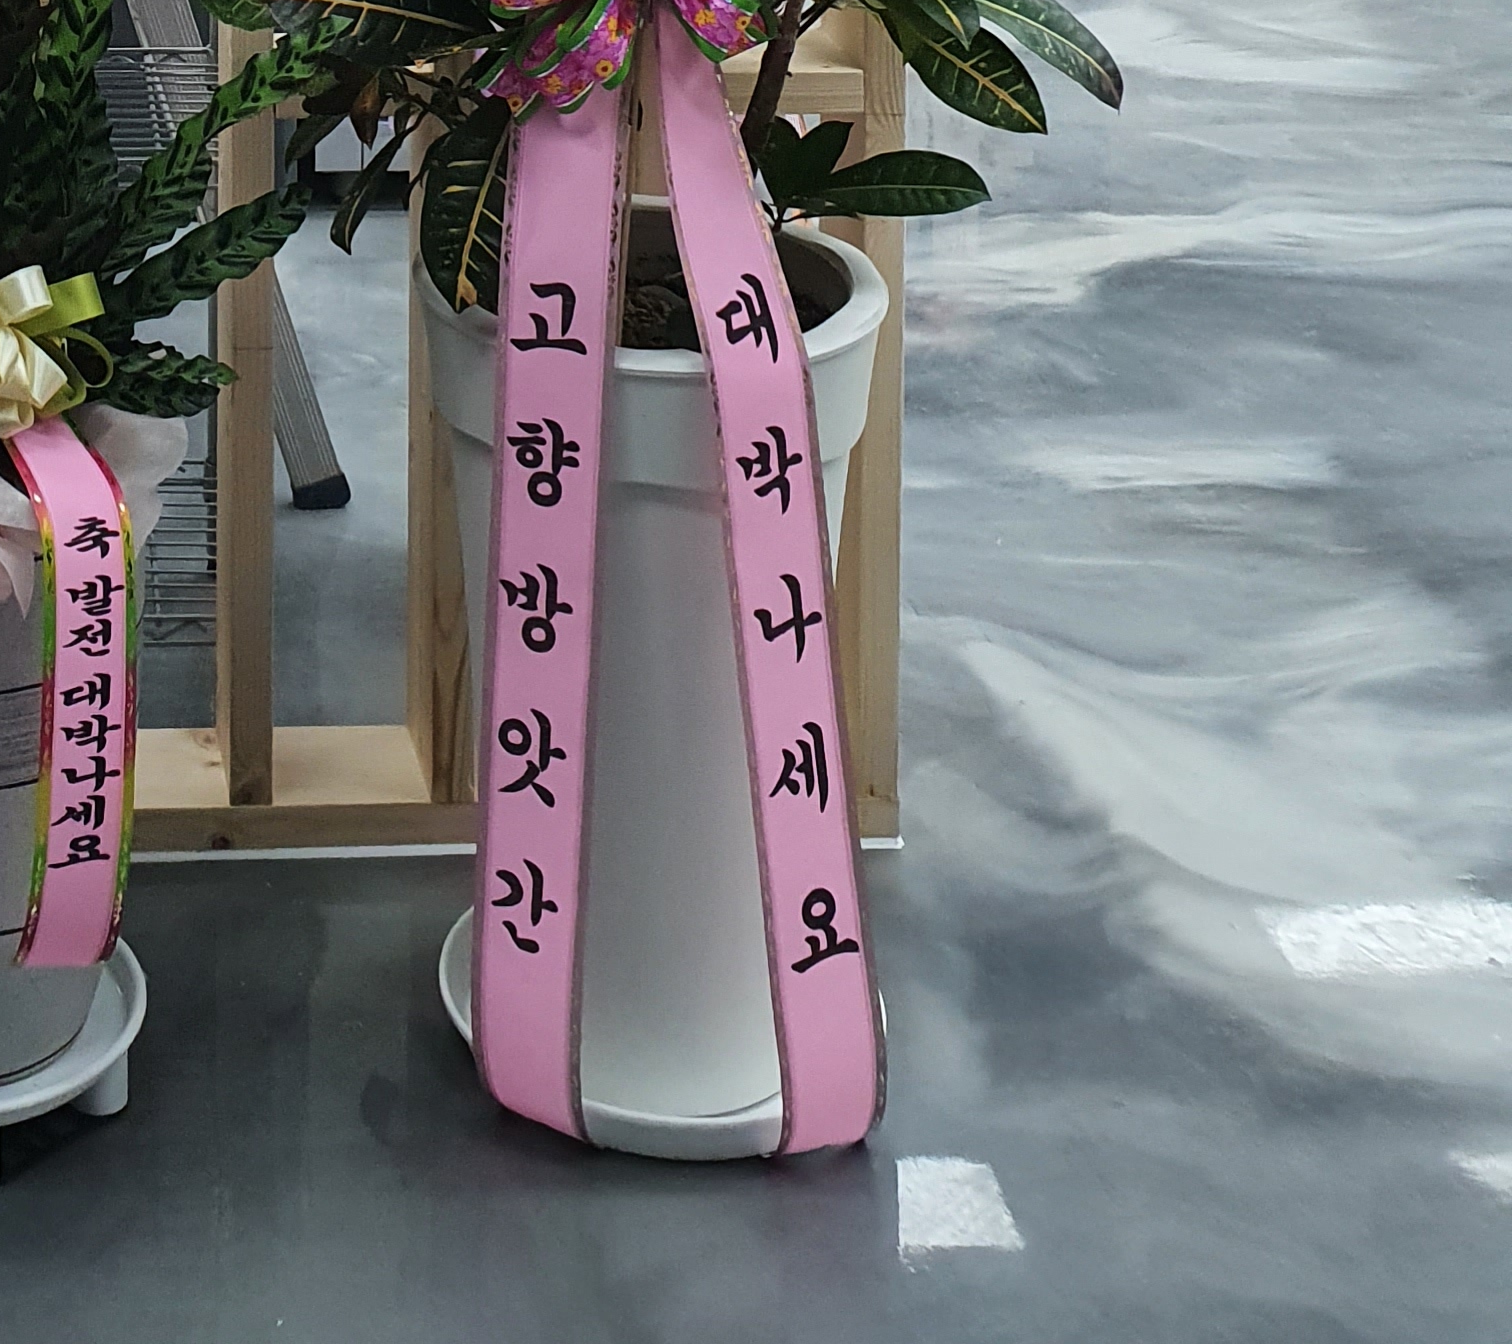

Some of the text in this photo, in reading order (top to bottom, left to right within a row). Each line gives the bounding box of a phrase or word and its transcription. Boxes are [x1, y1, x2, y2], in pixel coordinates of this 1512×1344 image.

[48, 516, 125, 870] 축 발전 대박나세요
